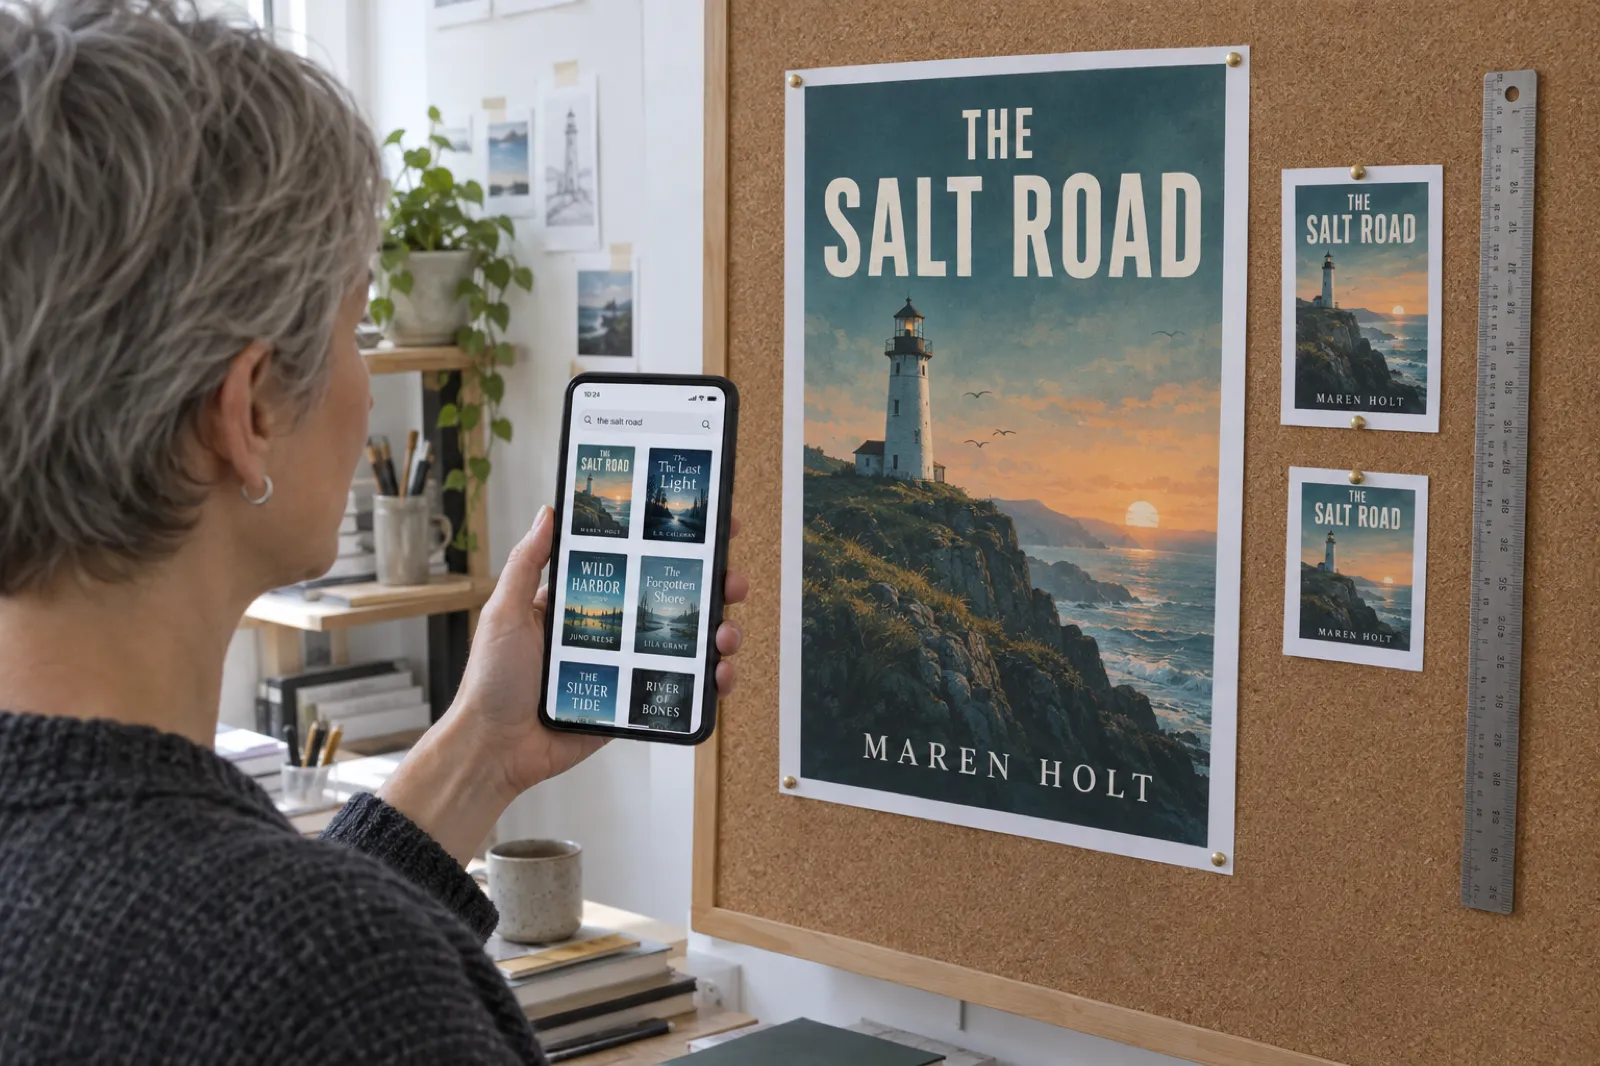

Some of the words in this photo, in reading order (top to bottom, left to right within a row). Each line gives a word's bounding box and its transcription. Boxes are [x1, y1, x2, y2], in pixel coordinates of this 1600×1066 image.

[962, 107, 1033, 160] THE
[1347, 193, 1371, 211] THE
[824, 176, 983, 278] SALT
[1013, 172, 1202, 279] ROAD
[1306, 214, 1353, 245] SALT
[1361, 213, 1416, 244] ROAD
[1316, 392, 1361, 405] MAREN
[1369, 395, 1404, 408] HOLT
[597, 417, 609, 425] the
[610, 417, 624, 425] salt
[625, 418, 643, 426] road
[581, 457, 603, 471] SALT
[605, 458, 629, 472] ROAD
[658, 460, 676, 473] The
[678, 461, 701, 475] Last
[660, 474, 697, 493] Light
[1349, 489, 1366, 503] THE
[1314, 502, 1352, 527] SALT
[1358, 505, 1401, 530] ROAD
[581, 561, 614, 577] WILD
[664, 566, 680, 577] The
[572, 577, 620, 595] HARBOR
[646, 576, 696, 592] Forgotten
[654, 591, 686, 605] Shore
[569, 633, 589, 642] JUNO
[591, 635, 614, 644] REESE
[1318, 627, 1357, 640] MAREN
[1362, 632, 1393, 644] HOLT
[644, 639, 660, 648] LILA
[662, 641, 688, 651] GRANT
[579, 671, 598, 682] THE
[566, 682, 608, 698] SILVER
[646, 682, 679, 694] RIVER
[572, 697, 600, 711] TIDE
[656, 695, 670, 704] OF
[642, 704, 680, 718] BONES
[862, 732, 1010, 780] MAREN
[1039, 758, 1153, 803] HOLT
